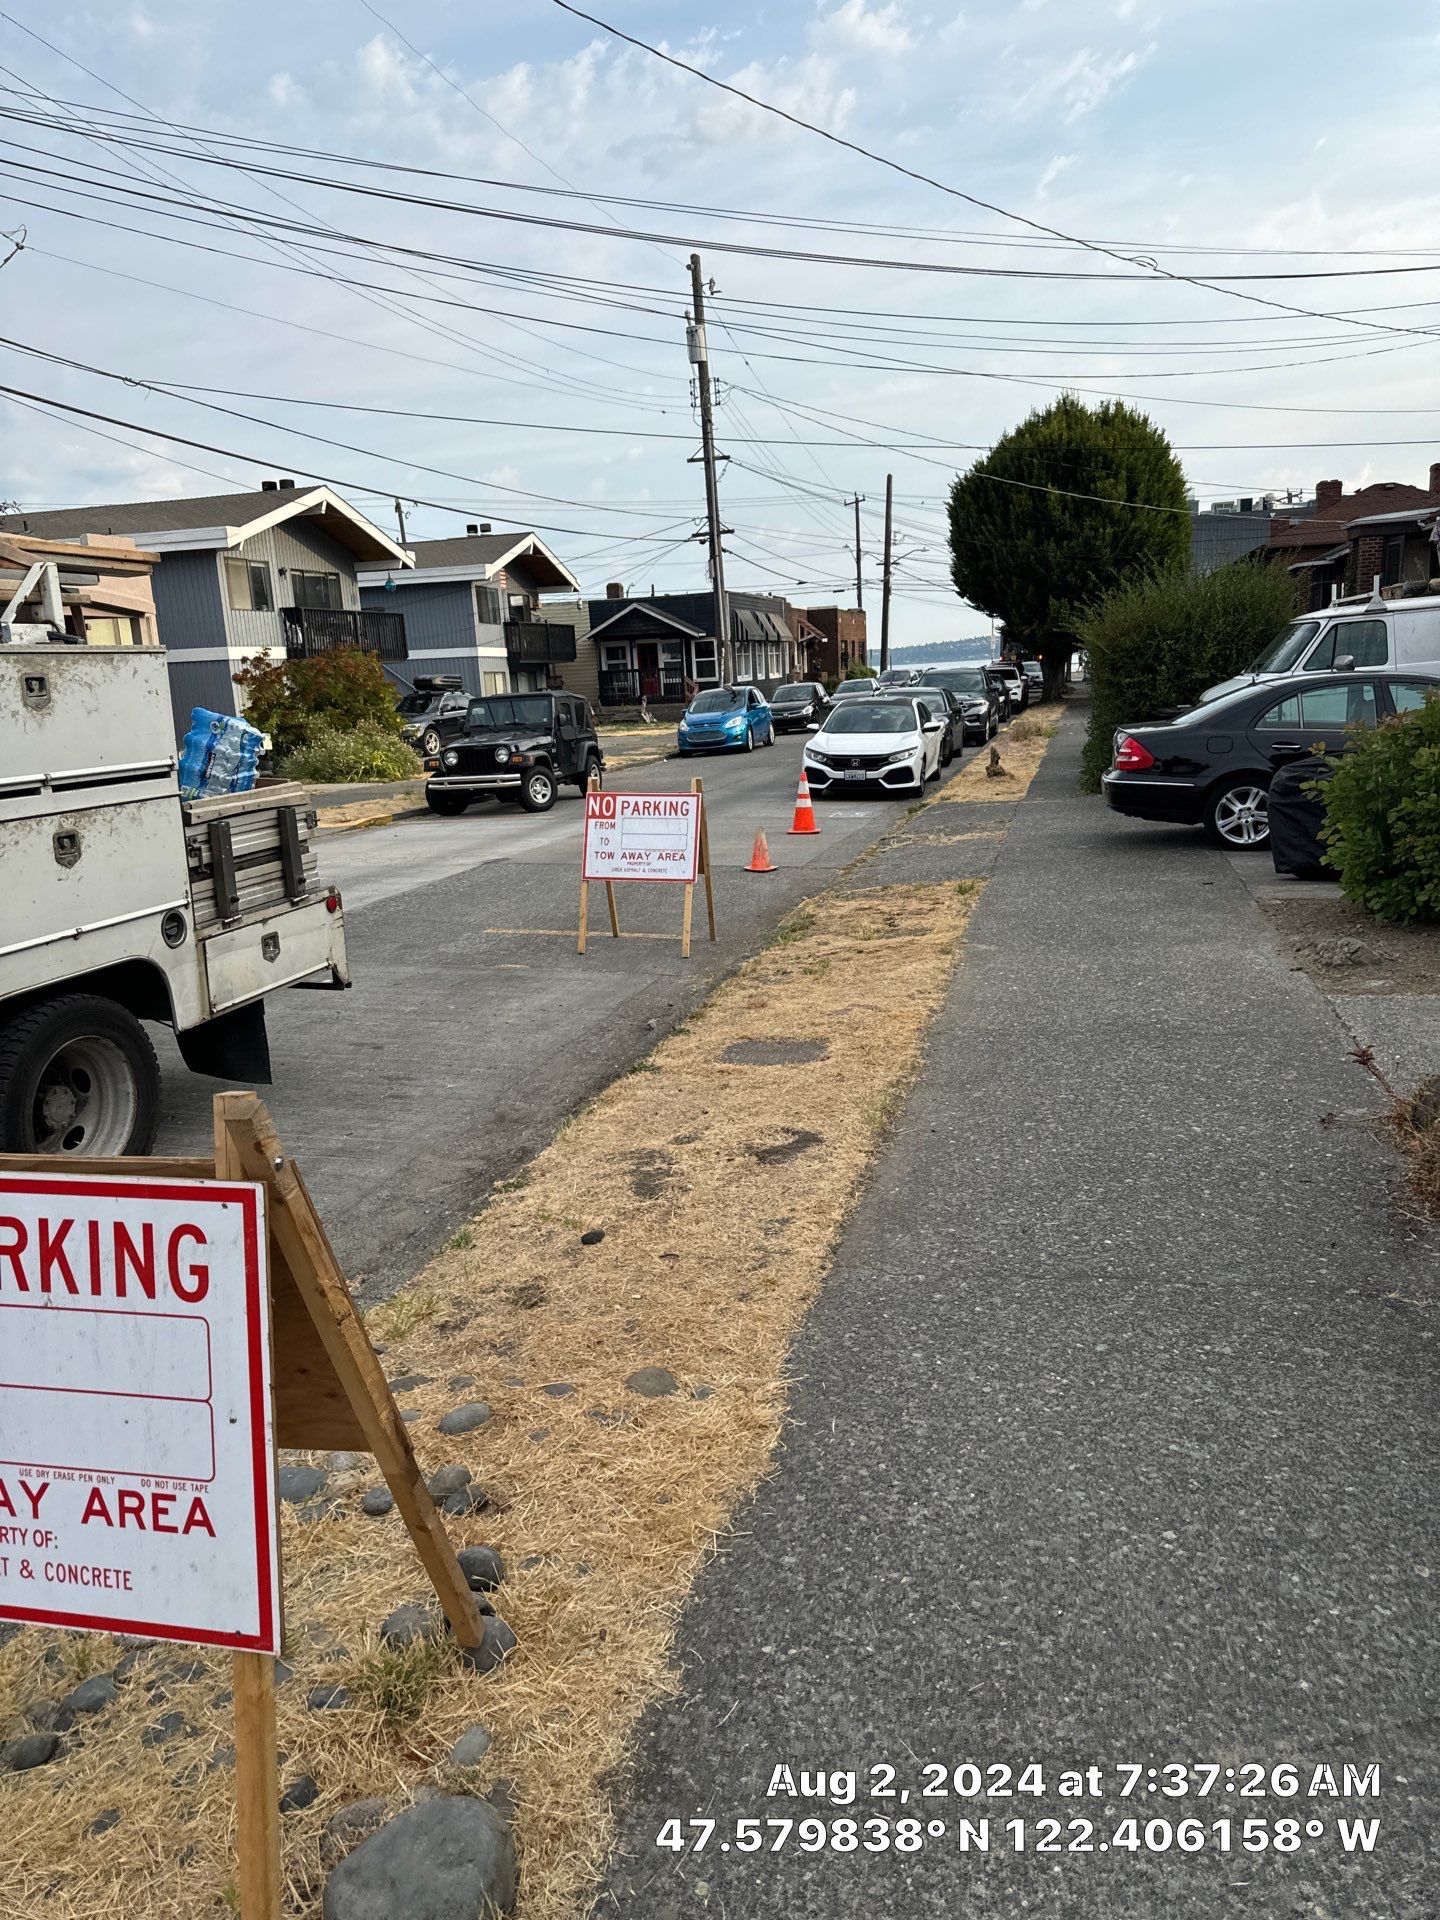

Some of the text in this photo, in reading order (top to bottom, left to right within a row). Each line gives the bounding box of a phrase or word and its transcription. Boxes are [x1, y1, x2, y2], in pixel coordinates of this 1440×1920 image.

[588, 796, 690, 817] NO PARKING
[594, 821, 616, 830] FROM
[600, 837, 610, 846] TO
[594, 851, 686, 862] TOW AWAY AREA
[18, 1467, 115, 1485] USE DRY ERASE PEN ONLY
[140, 1478, 209, 1494] DO NOT USE TAPE
[81, 1487, 217, 1537] AREA
[32, 1529, 58, 1549] OF:
[19, 1558, 35, 1580] &
[44, 1561, 133, 1591] CONCRETE
